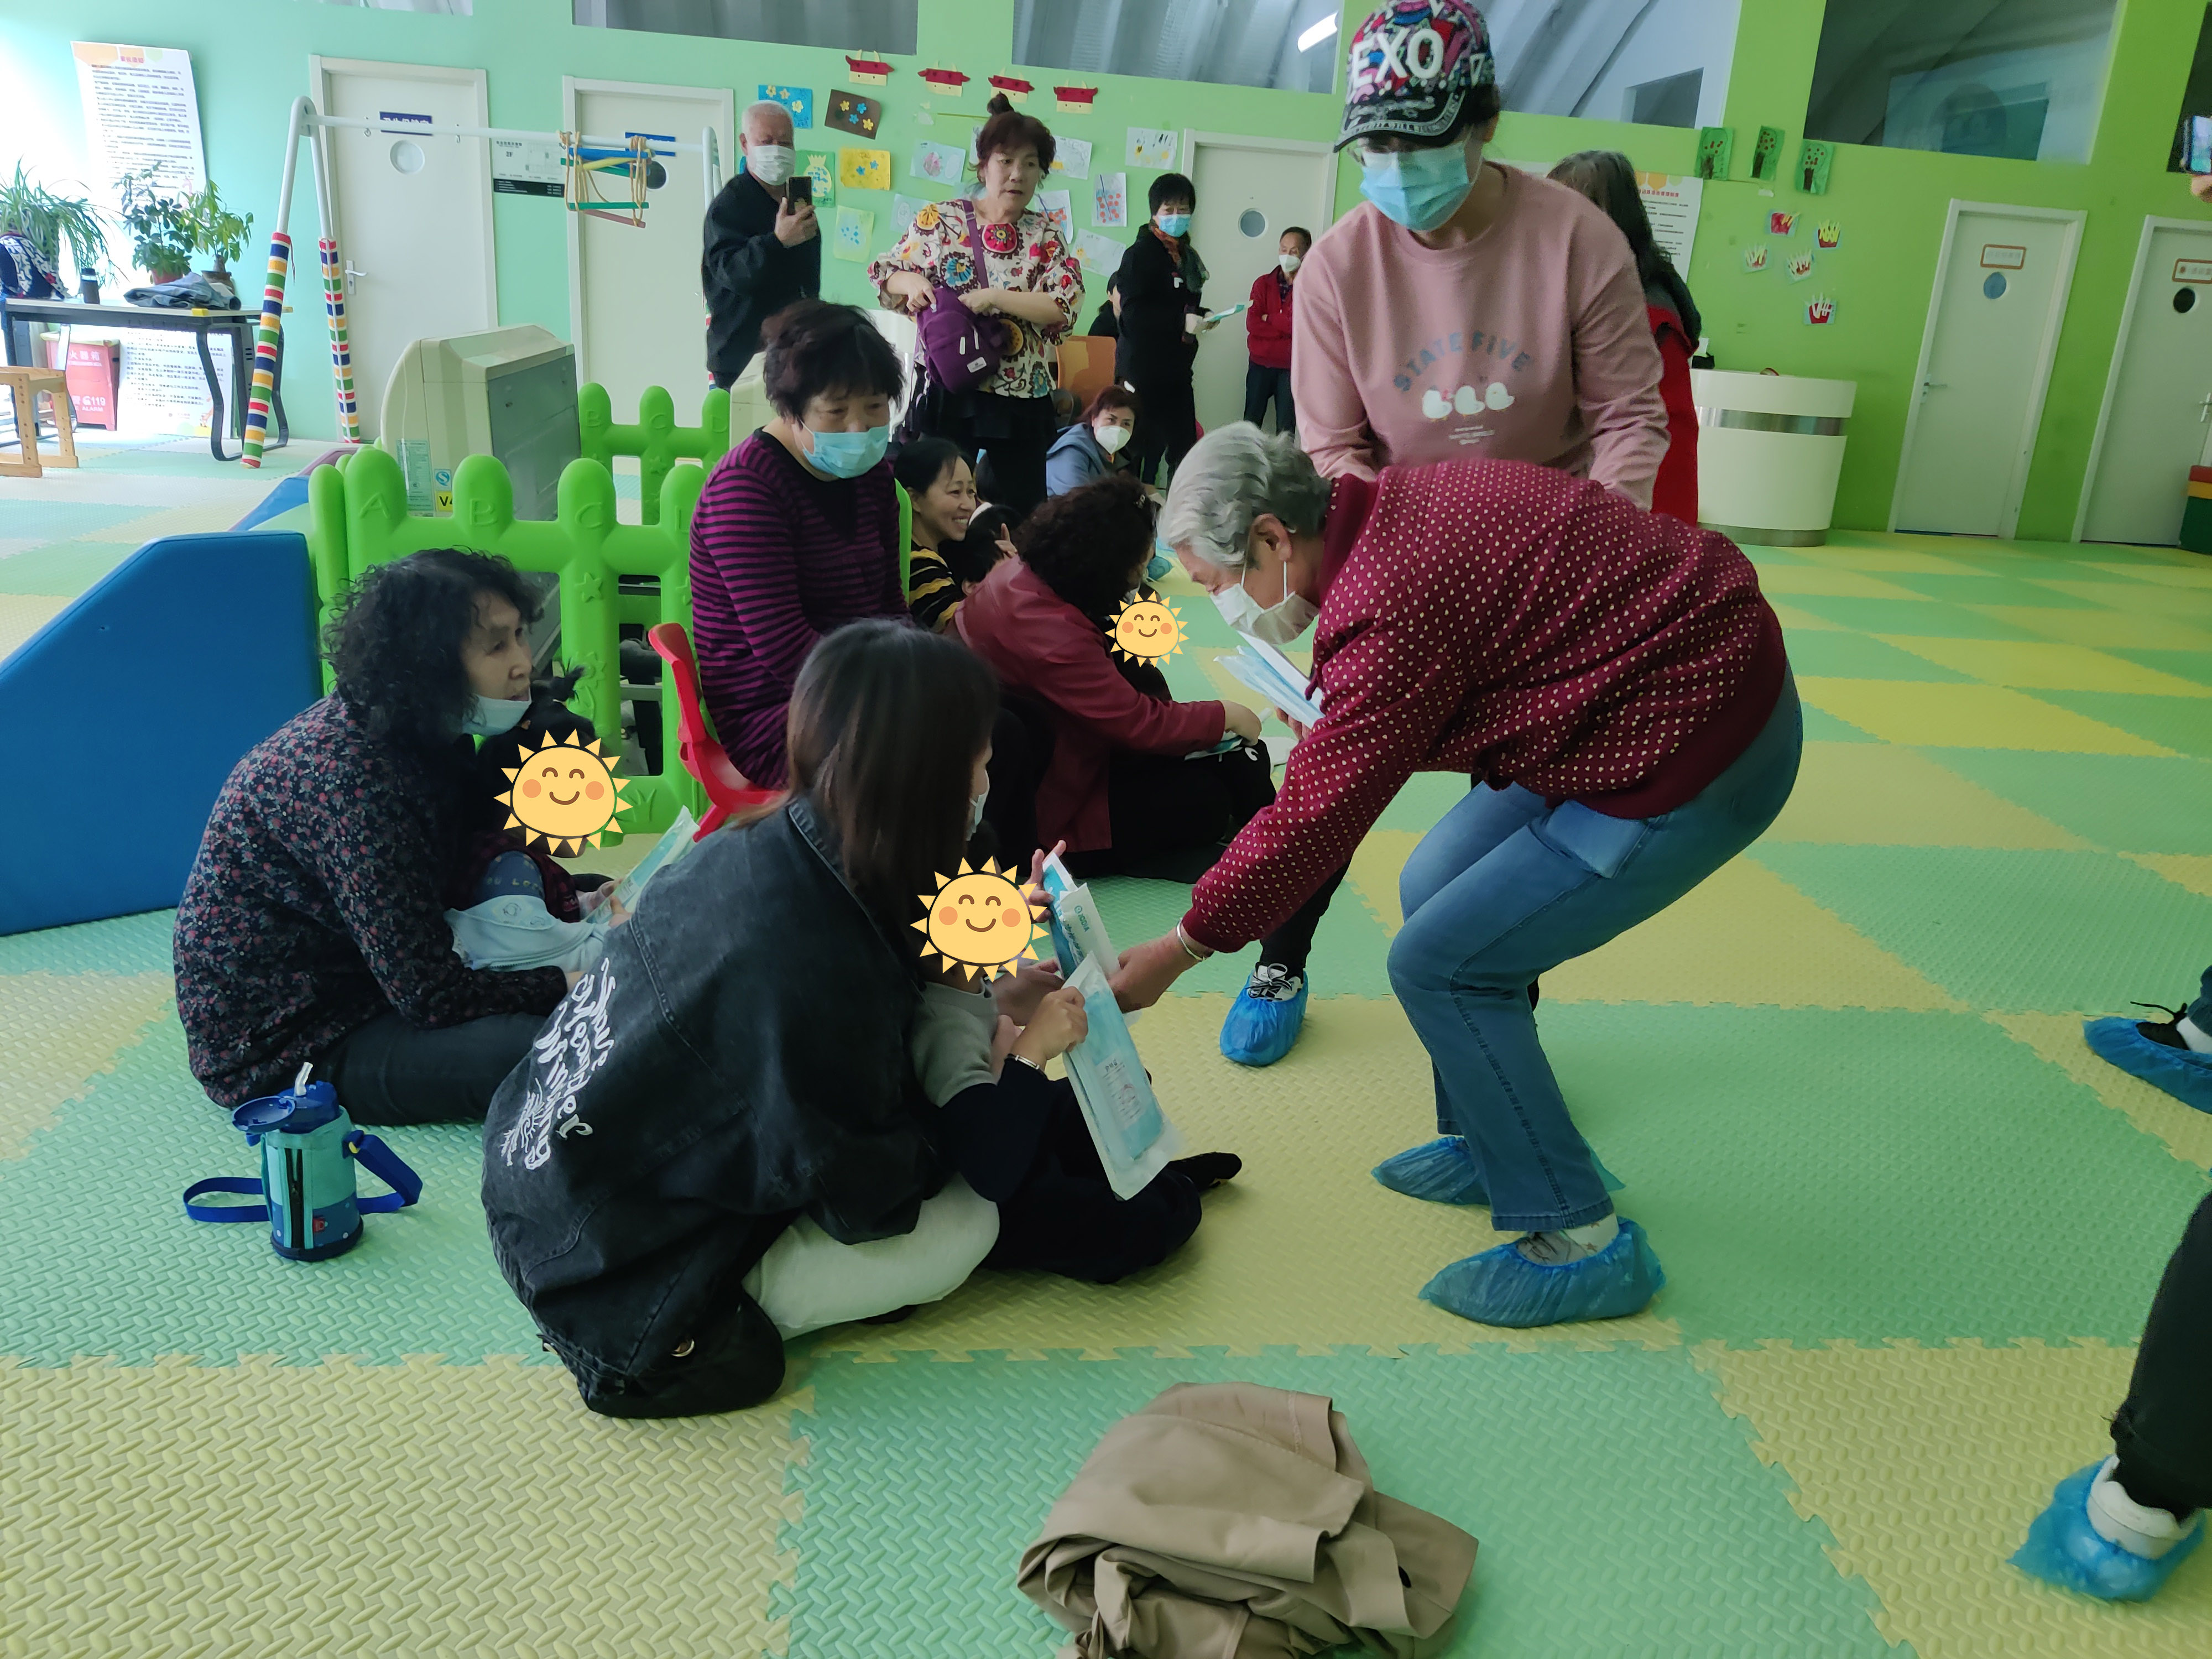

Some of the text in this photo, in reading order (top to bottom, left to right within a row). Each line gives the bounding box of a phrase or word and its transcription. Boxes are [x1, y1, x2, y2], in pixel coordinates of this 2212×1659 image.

[1352, 28, 1444, 88] EXO
[1472, 330, 1531, 372] FIVE
[91, 396, 106, 406] 119
[359, 492, 391, 519] A
[469, 498, 499, 527] B
[575, 502, 603, 529] C
